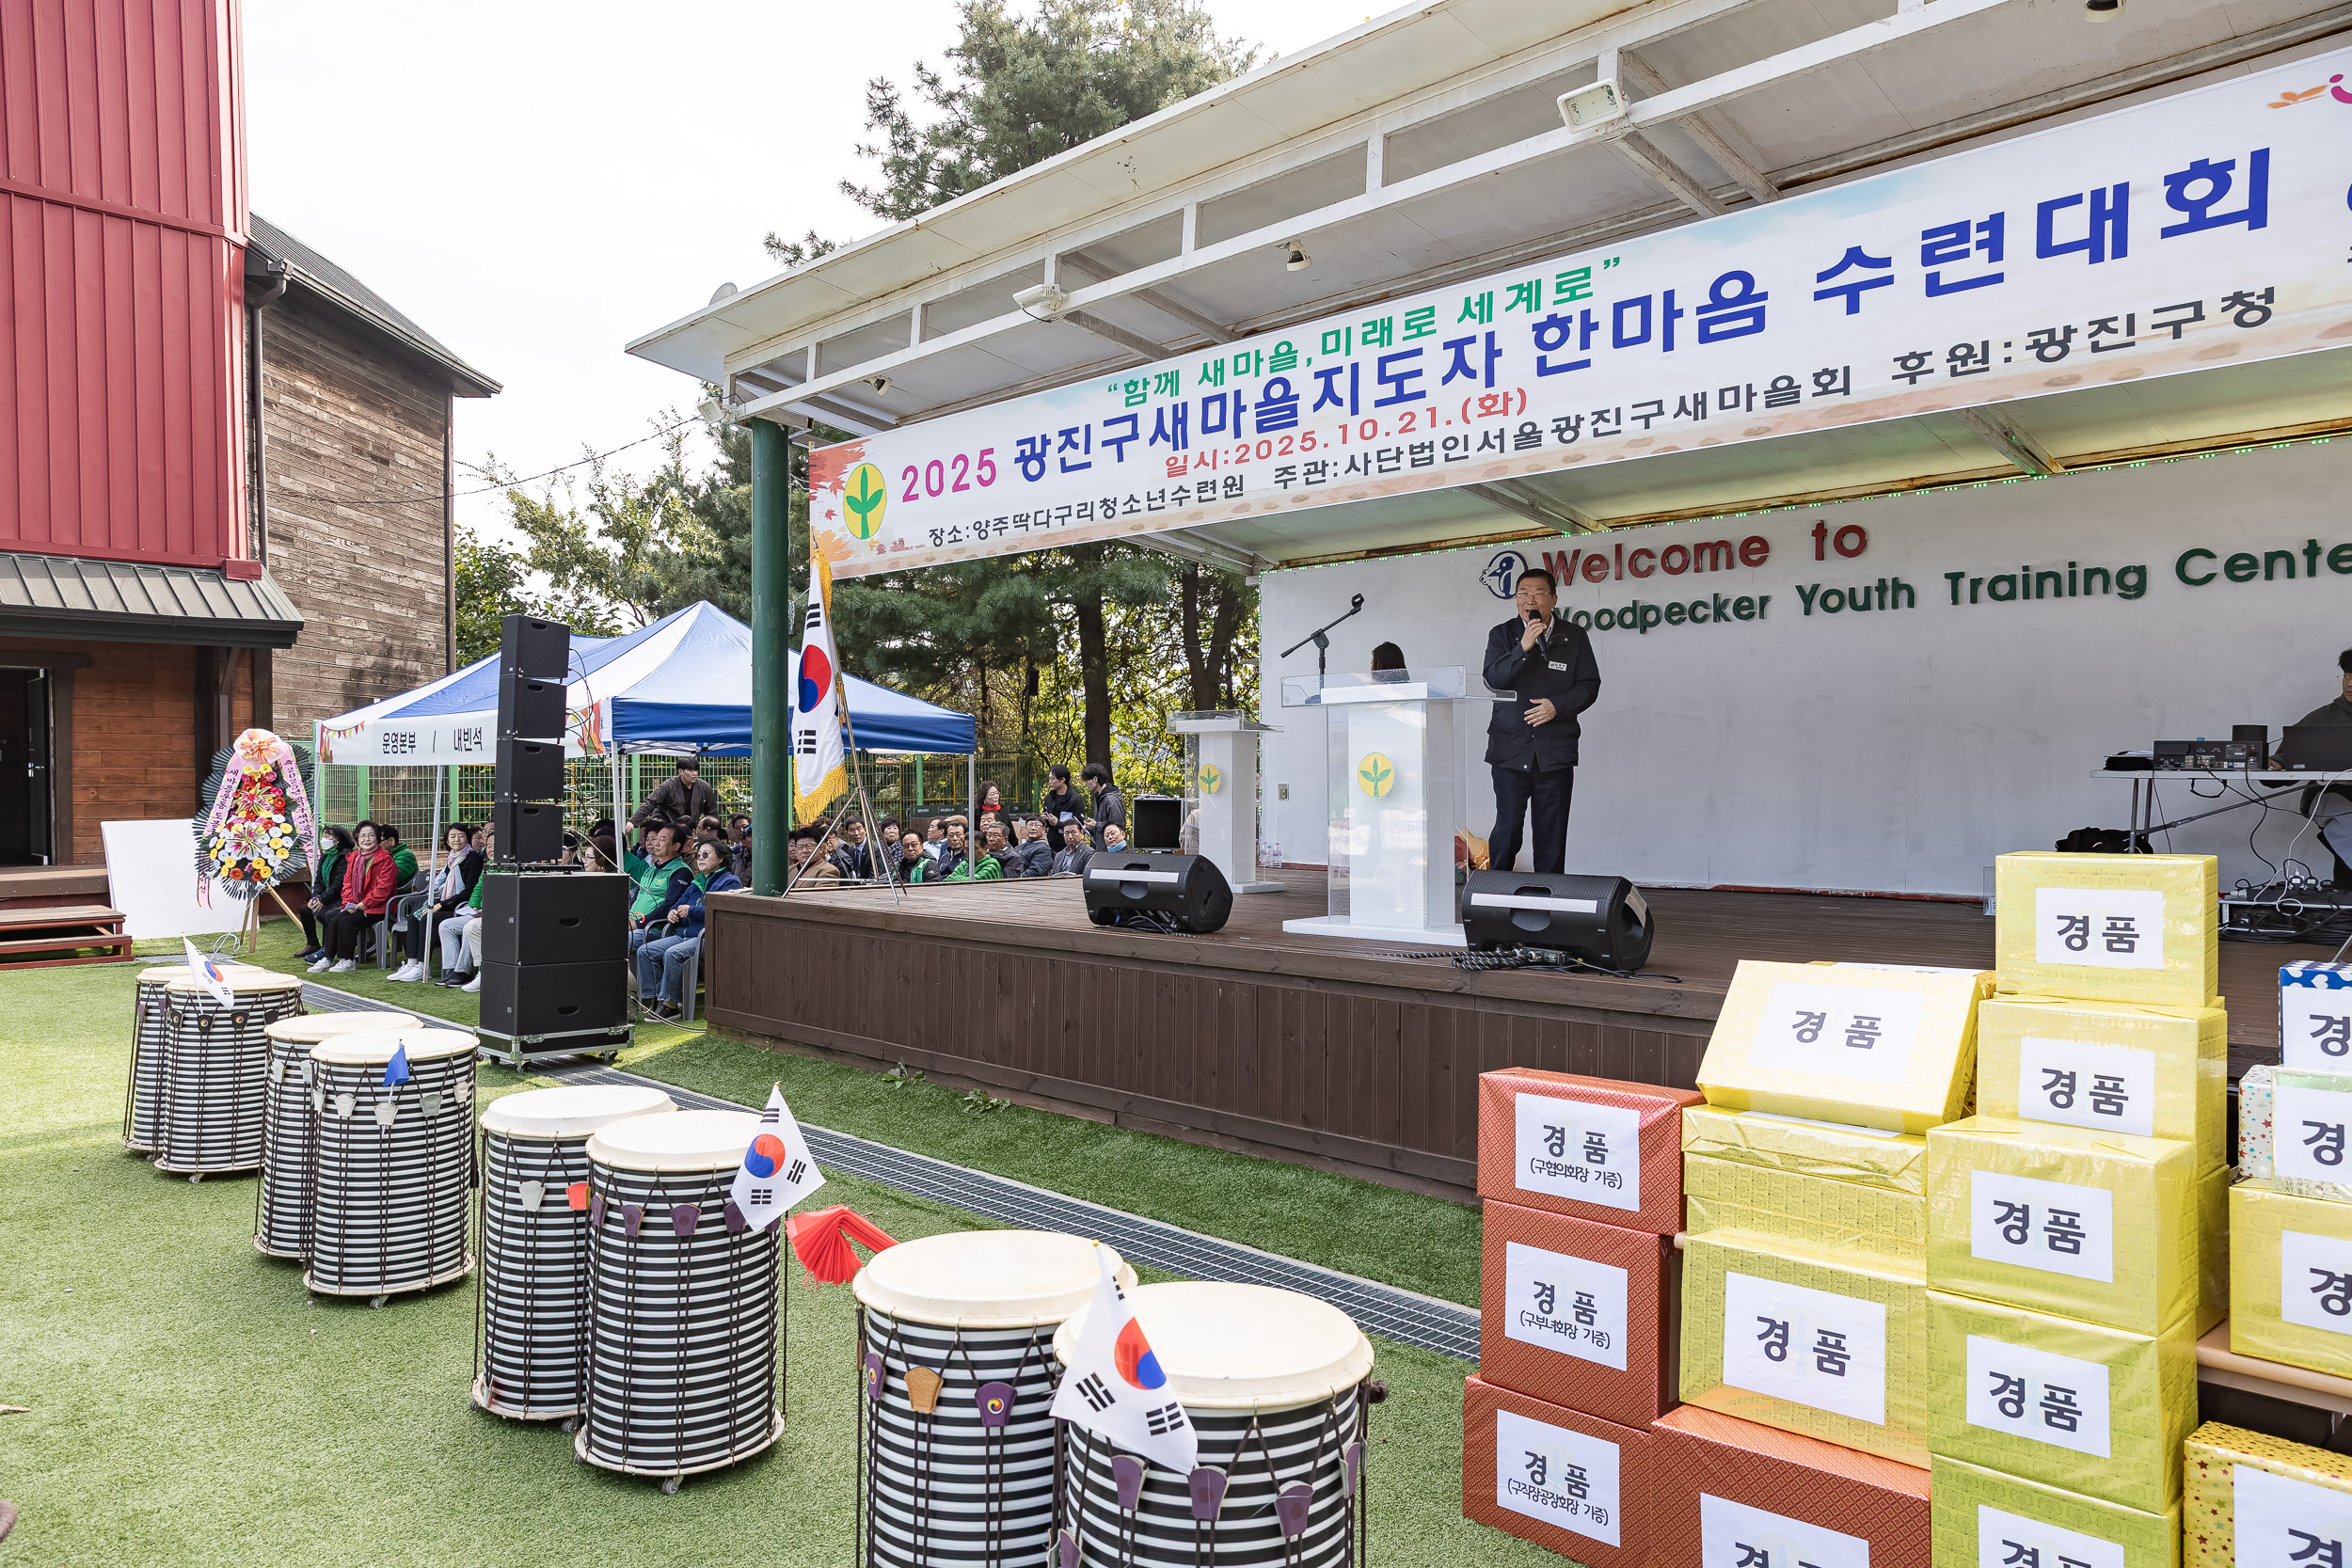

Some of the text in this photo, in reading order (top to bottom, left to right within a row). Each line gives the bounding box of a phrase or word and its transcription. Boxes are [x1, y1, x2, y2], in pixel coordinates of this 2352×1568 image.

[901, 147, 2270, 503] 2025 광진구새마을지도자 한마음 수련대회
[1107, 369, 1180, 407] “함께
[1456, 256, 1621, 325] 세계로”
[1891, 286, 2275, 386] 후원:광진구청
[1542, 520, 1868, 587] Welcome to
[1795, 576, 1916, 616] Youth
[1944, 560, 2148, 606] Training
[382, 732, 417, 754] 운영본부
[453, 726, 484, 752] 내빈석
[1530, 1157, 1623, 1190] (구협의회장 기증)
[1520, 1309, 1611, 1350] (구부녀회장 기증)
[1584, 1503, 1609, 1527] 기증)
